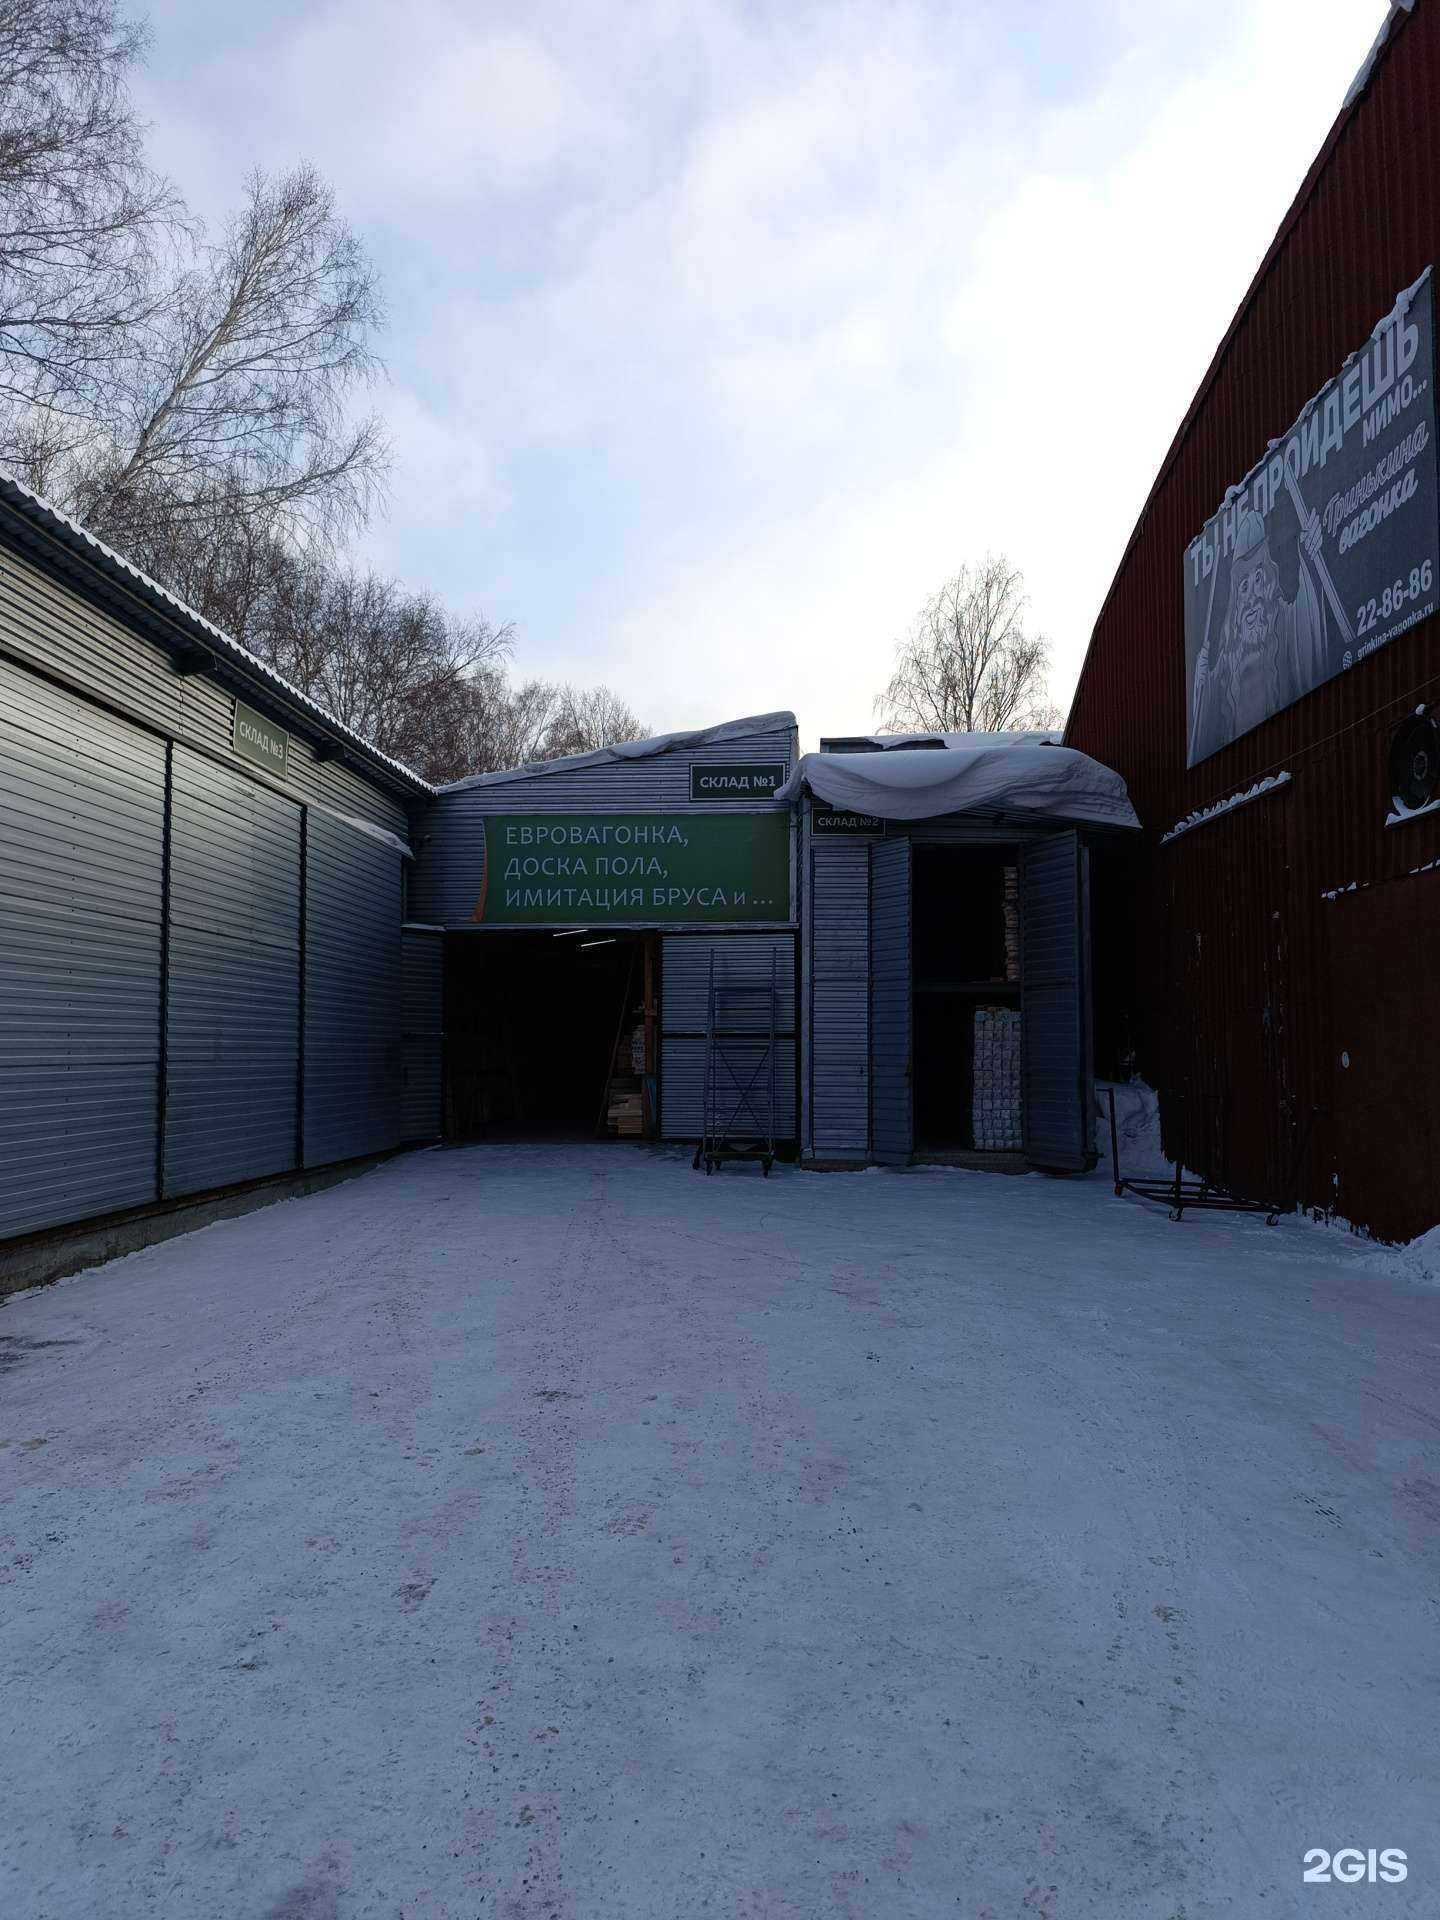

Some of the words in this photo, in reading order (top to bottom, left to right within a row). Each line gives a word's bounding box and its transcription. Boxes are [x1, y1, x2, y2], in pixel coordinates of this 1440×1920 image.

[1338, 467, 1419, 555] вагонка
[1190, 521, 1220, 587] ТЫ
[1356, 559, 1433, 637] 22-86-86
[1357, 601, 1435, 661] grinkina-vagonka.ru
[239, 721, 269, 754] СКЛАД
[270, 739, 284, 759] №3
[700, 776, 750, 790] СКЛАД
[753, 775, 776, 788] №1
[505, 825, 689, 848] ЕВРОВАГОНКА,
[817, 816, 858, 828] СКЛАД
[859, 816, 880, 827] №2
[504, 857, 589, 881] ДОСКА
[595, 857, 669, 880] ПОЛА,
[505, 887, 644, 912] ИМИТАЦИЯ
[652, 887, 728, 906] БРУСА
